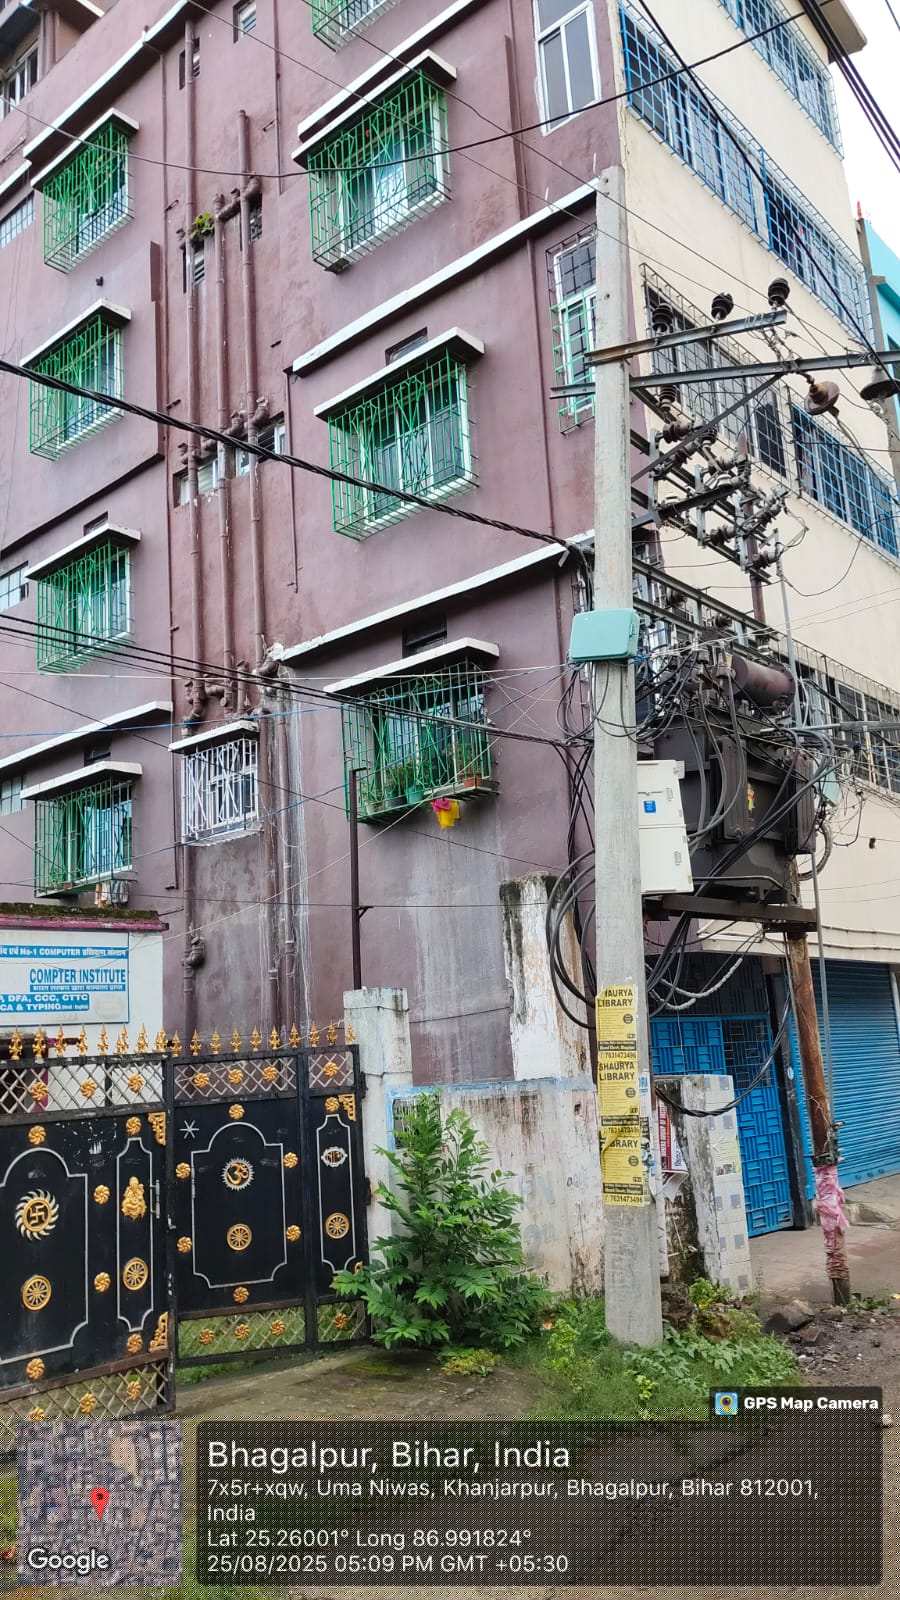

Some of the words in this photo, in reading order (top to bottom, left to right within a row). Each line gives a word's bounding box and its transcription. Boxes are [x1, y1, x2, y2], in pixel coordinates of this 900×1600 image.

[40, 948, 81, 956] COMPUTER
[30, 969, 76, 983] COMPTER
[80, 969, 126, 983] INSTITUTE
[8, 994, 32, 1003] DFA,
[34, 994, 60, 1002] CCC,
[598, 998, 633, 1007] LIBRARY
[598, 1062, 635, 1071] SHAURYA
[599, 1072, 635, 1081] LIBRARY
